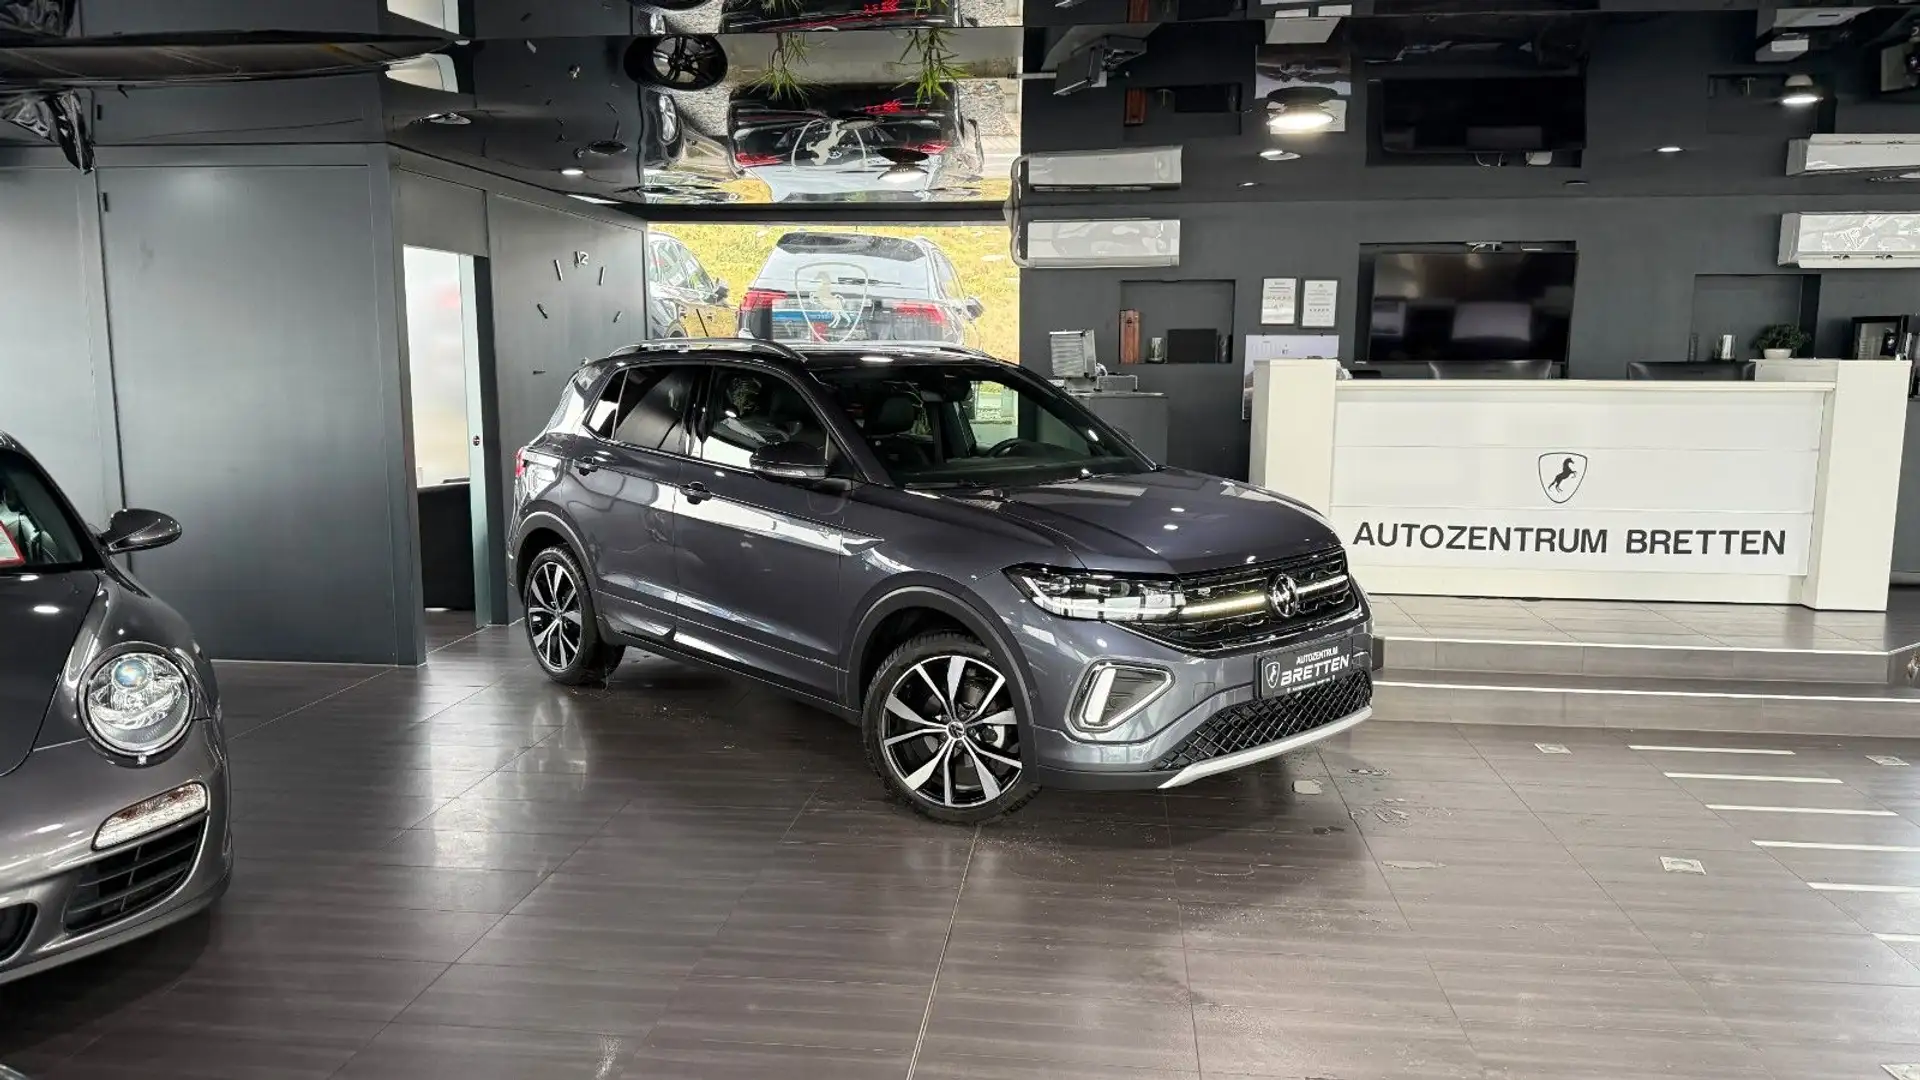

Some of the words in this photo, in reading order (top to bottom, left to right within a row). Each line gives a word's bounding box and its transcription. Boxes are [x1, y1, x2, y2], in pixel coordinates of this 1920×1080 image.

[574, 251, 589, 266] 12
[1352, 521, 1608, 554] AUTOZENTRUM
[1625, 529, 1786, 555] BRETTEN
[1296, 646, 1338, 665] AUTOZENTRUM
[1280, 654, 1349, 687] BRETTEN
